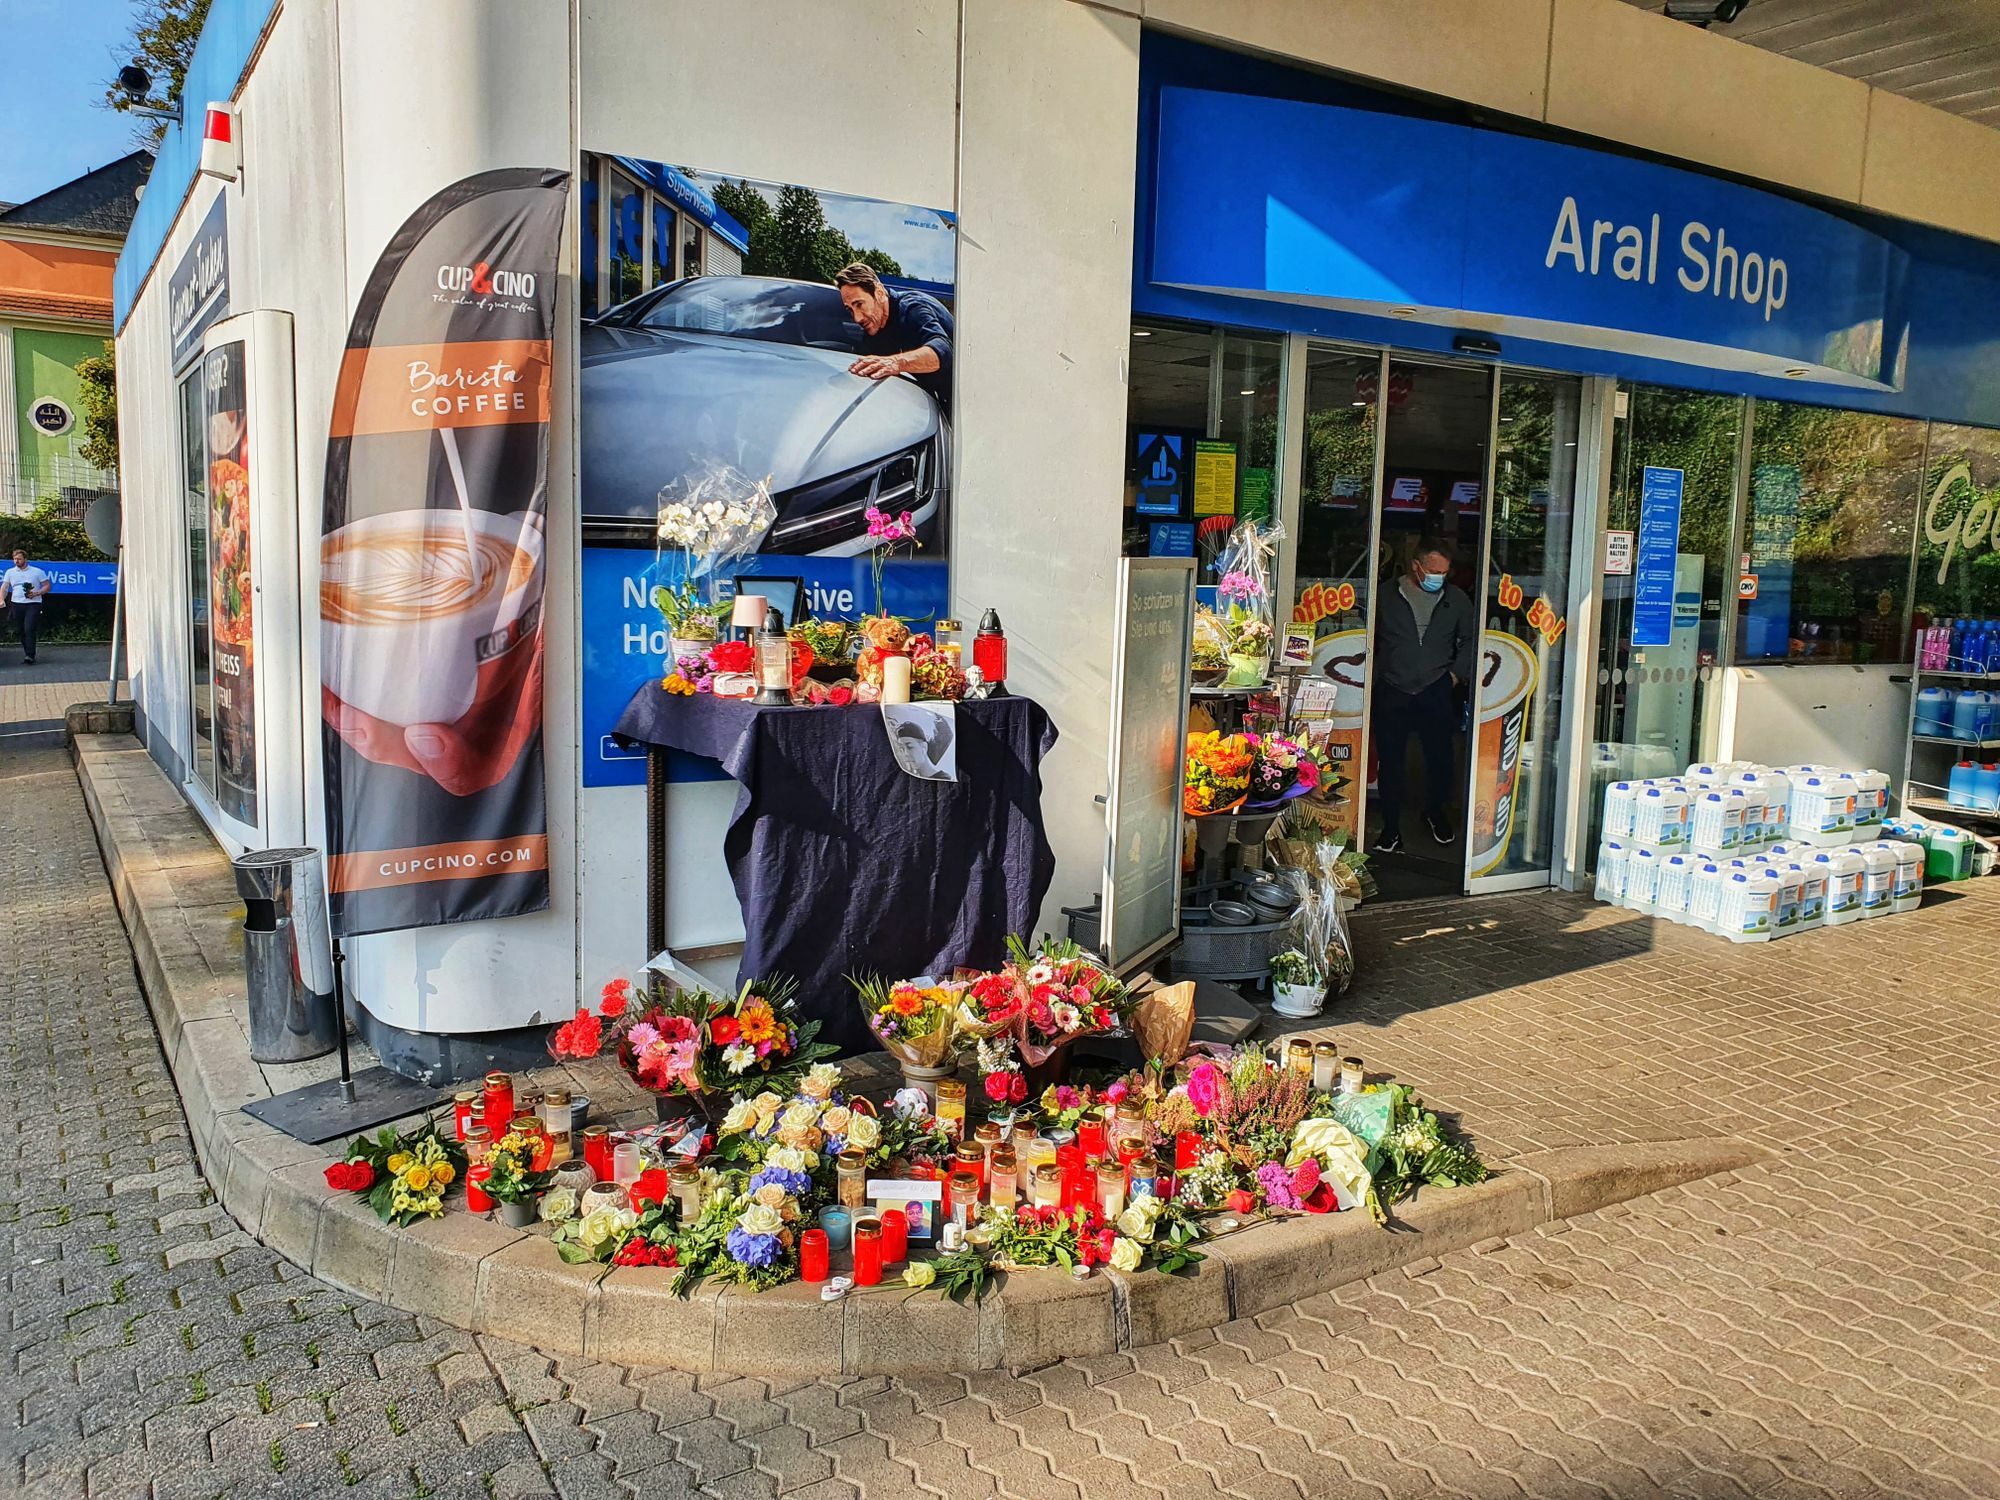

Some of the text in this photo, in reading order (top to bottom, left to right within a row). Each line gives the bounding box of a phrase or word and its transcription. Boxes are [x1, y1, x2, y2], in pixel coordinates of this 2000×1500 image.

[667, 171, 713, 219] SuperWash
[904, 220, 939, 230] www.aral.de
[1545, 196, 1788, 321] Aral Shop
[437, 262, 535, 298] CUP&CINO
[432, 295, 448, 303] The
[451, 296, 472, 304] value
[477, 298, 487, 309] of
[487, 301, 509, 311] great
[407, 360, 524, 393] Barista
[411, 392, 526, 416] COFFEE
[1740, 582, 1755, 591] DKV
[1498, 573, 1523, 610] to
[1527, 598, 1566, 646] go!
[1331, 746, 1349, 758] CINO
[379, 848, 531, 876] CUPCINO.COM
